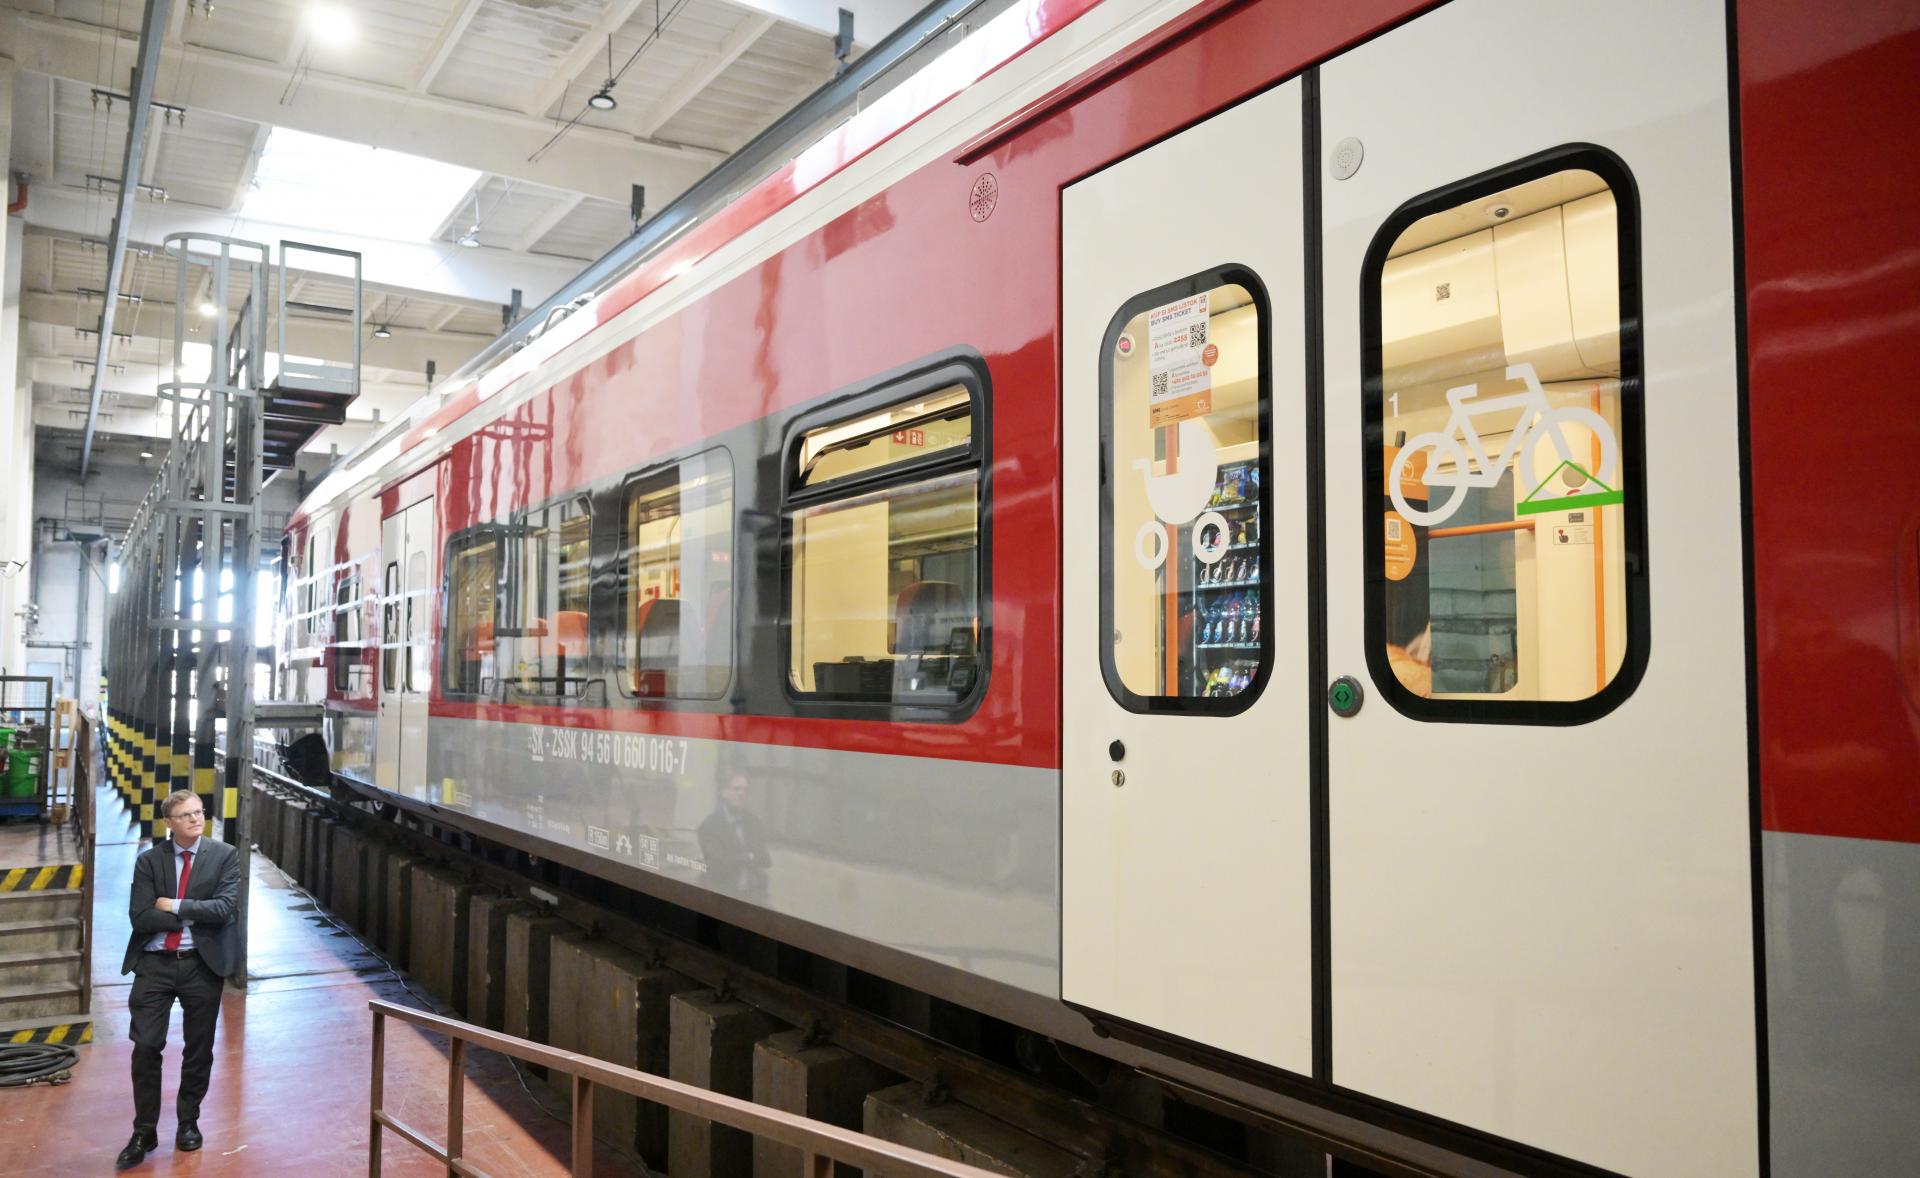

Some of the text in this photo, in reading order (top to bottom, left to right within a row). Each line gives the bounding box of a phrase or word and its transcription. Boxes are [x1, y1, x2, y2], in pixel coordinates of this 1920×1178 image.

[1151, 308, 1192, 326] BUY SMS TICKET
[1167, 304, 1178, 313] SMS
[1388, 392, 1399, 417] 1
[552, 729, 577, 759] ZSSK
[581, 731, 593, 762] 94
[597, 733, 610, 765] 56
[614, 734, 621, 766] 0
[624, 735, 646, 769] 660
[650, 737, 688, 775] 016-7
